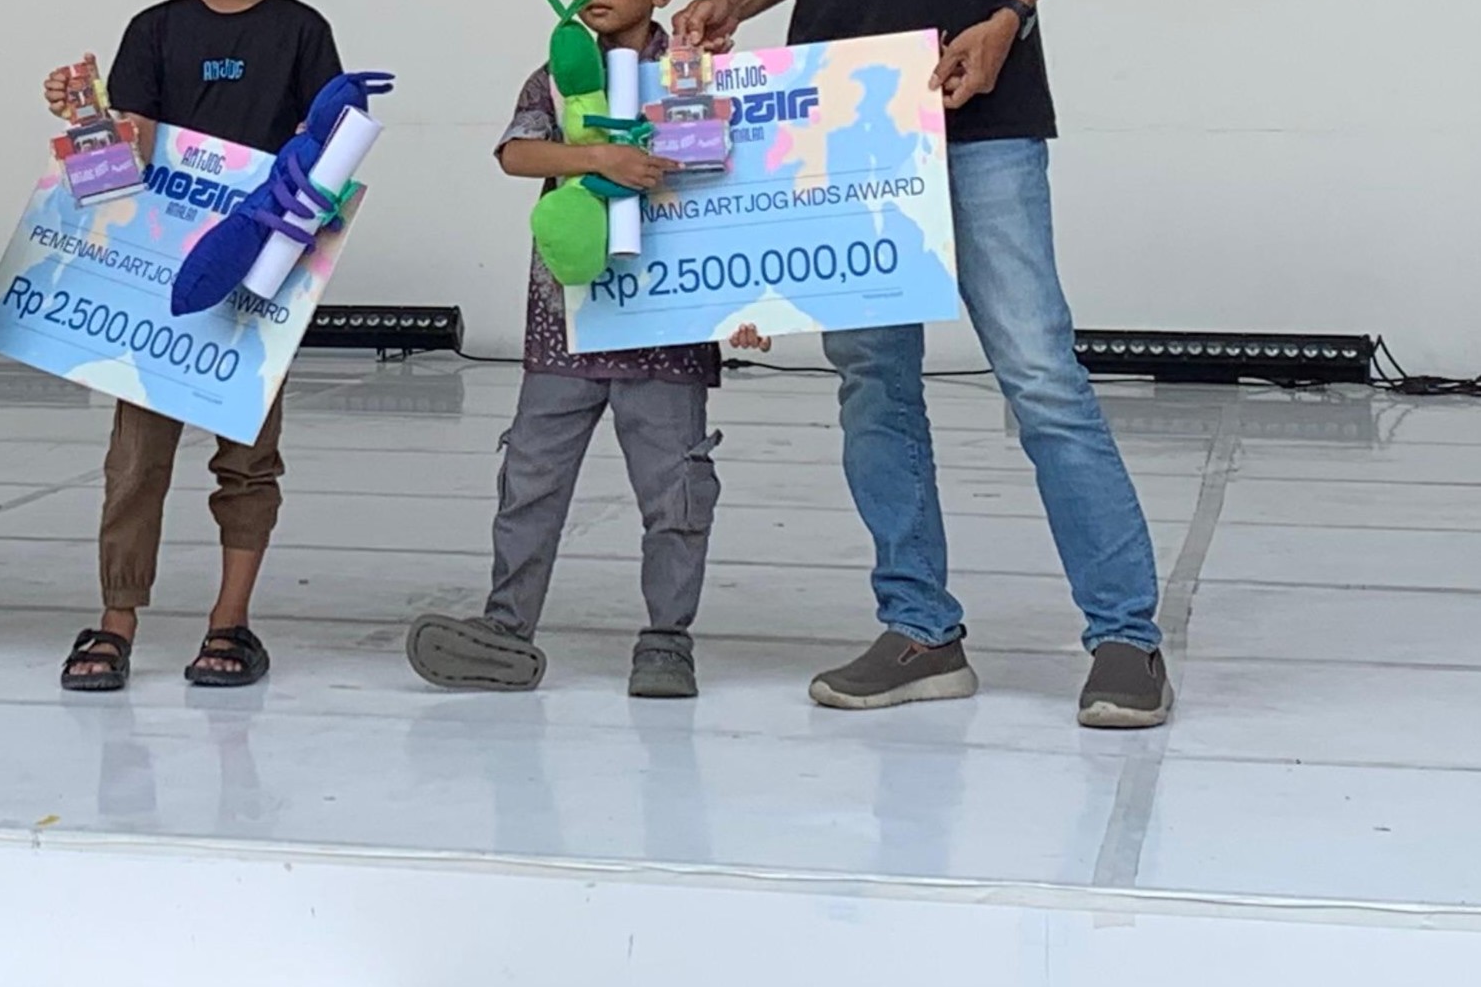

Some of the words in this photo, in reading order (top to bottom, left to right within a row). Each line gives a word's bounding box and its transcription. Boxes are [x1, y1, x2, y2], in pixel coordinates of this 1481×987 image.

[715, 65, 767, 91] ARTJOG
[180, 145, 226, 175] ARTJOG
[704, 190, 789, 215] ARTJOG
[792, 185, 841, 208] KIDS
[844, 176, 925, 201] AWARD
[29, 225, 120, 267] PEMENANG
[118, 255, 179, 287] ARTJO
[225, 290, 290, 324] AWARD
[591, 267, 639, 307] Rp
[648, 238, 898, 296] 2.500.000,00
[2, 275, 44, 319] Rp
[44, 290, 240, 382] 2.500.000,00
